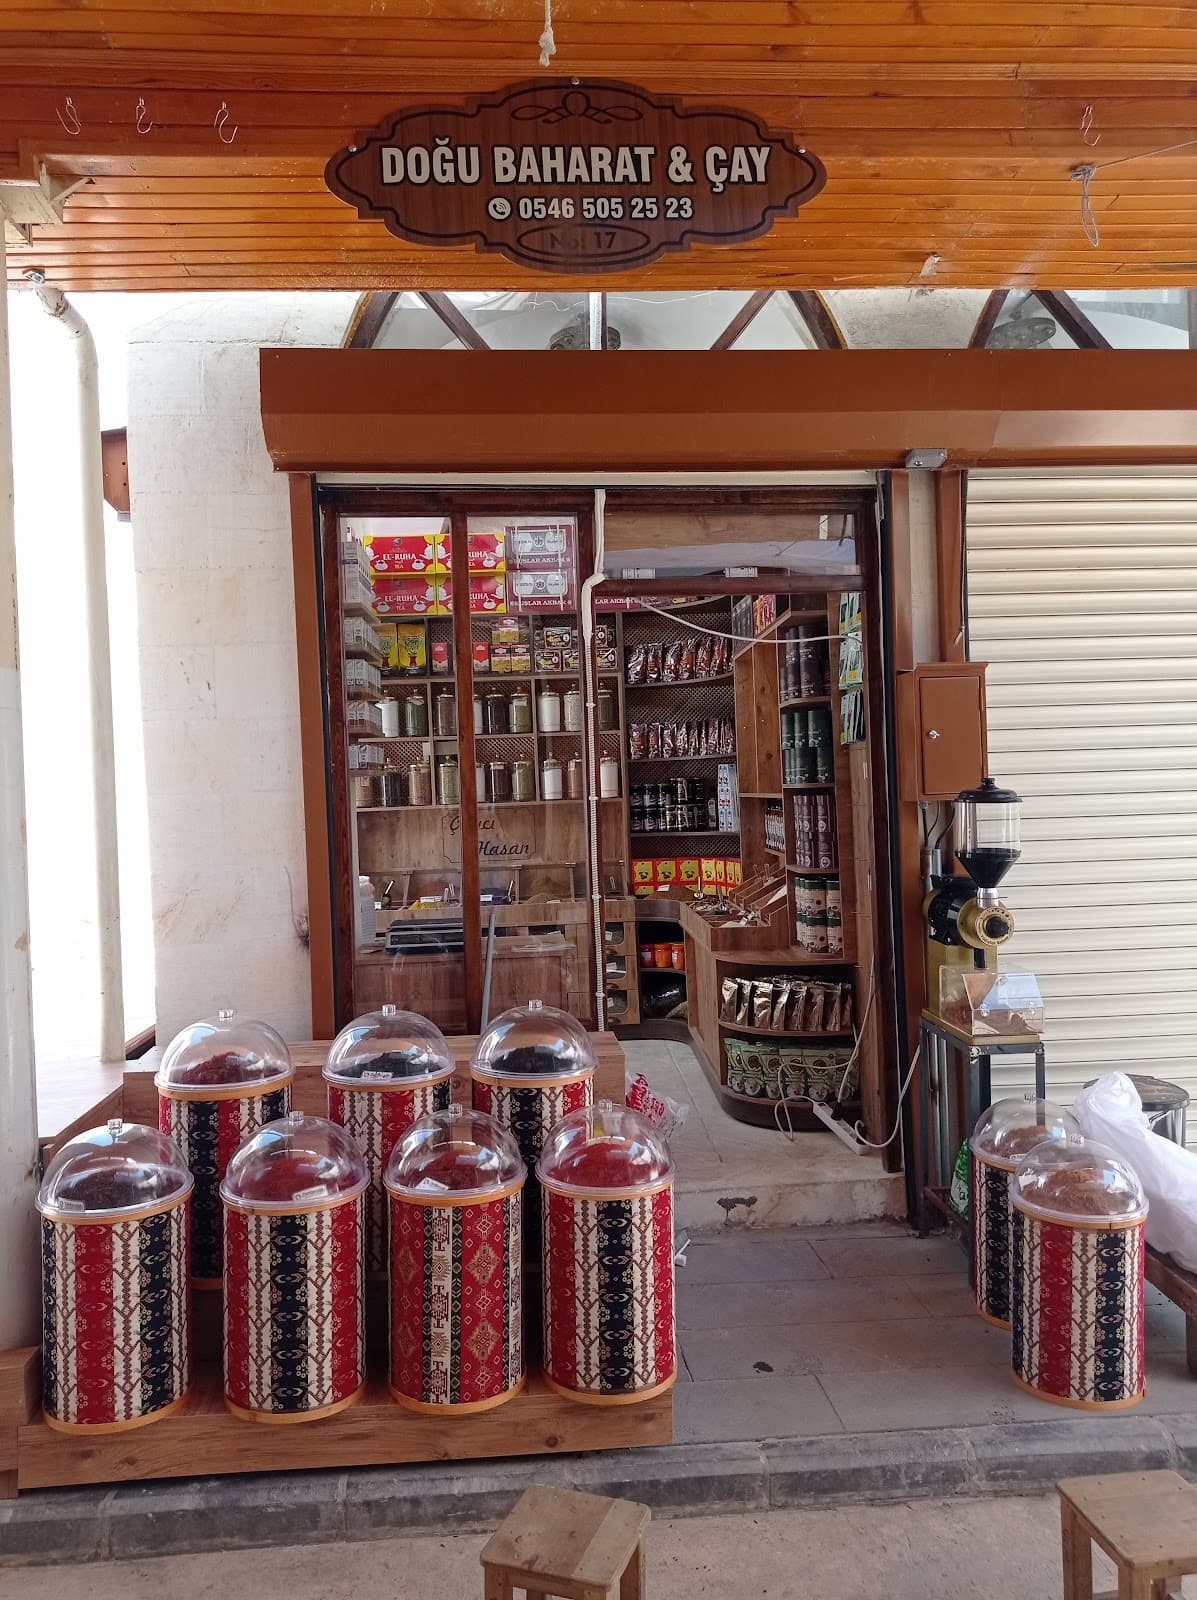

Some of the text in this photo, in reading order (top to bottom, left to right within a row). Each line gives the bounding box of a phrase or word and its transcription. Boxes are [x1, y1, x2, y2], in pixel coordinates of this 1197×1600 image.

[381, 137, 770, 192] DOĞU BAHARAT & ÇAY
[518, 197, 693, 219] 0546 505 25 23
[594, 231, 617, 249] 17
[382, 553, 417, 561] EL-RUHA
[479, 841, 529, 856] Hasan
